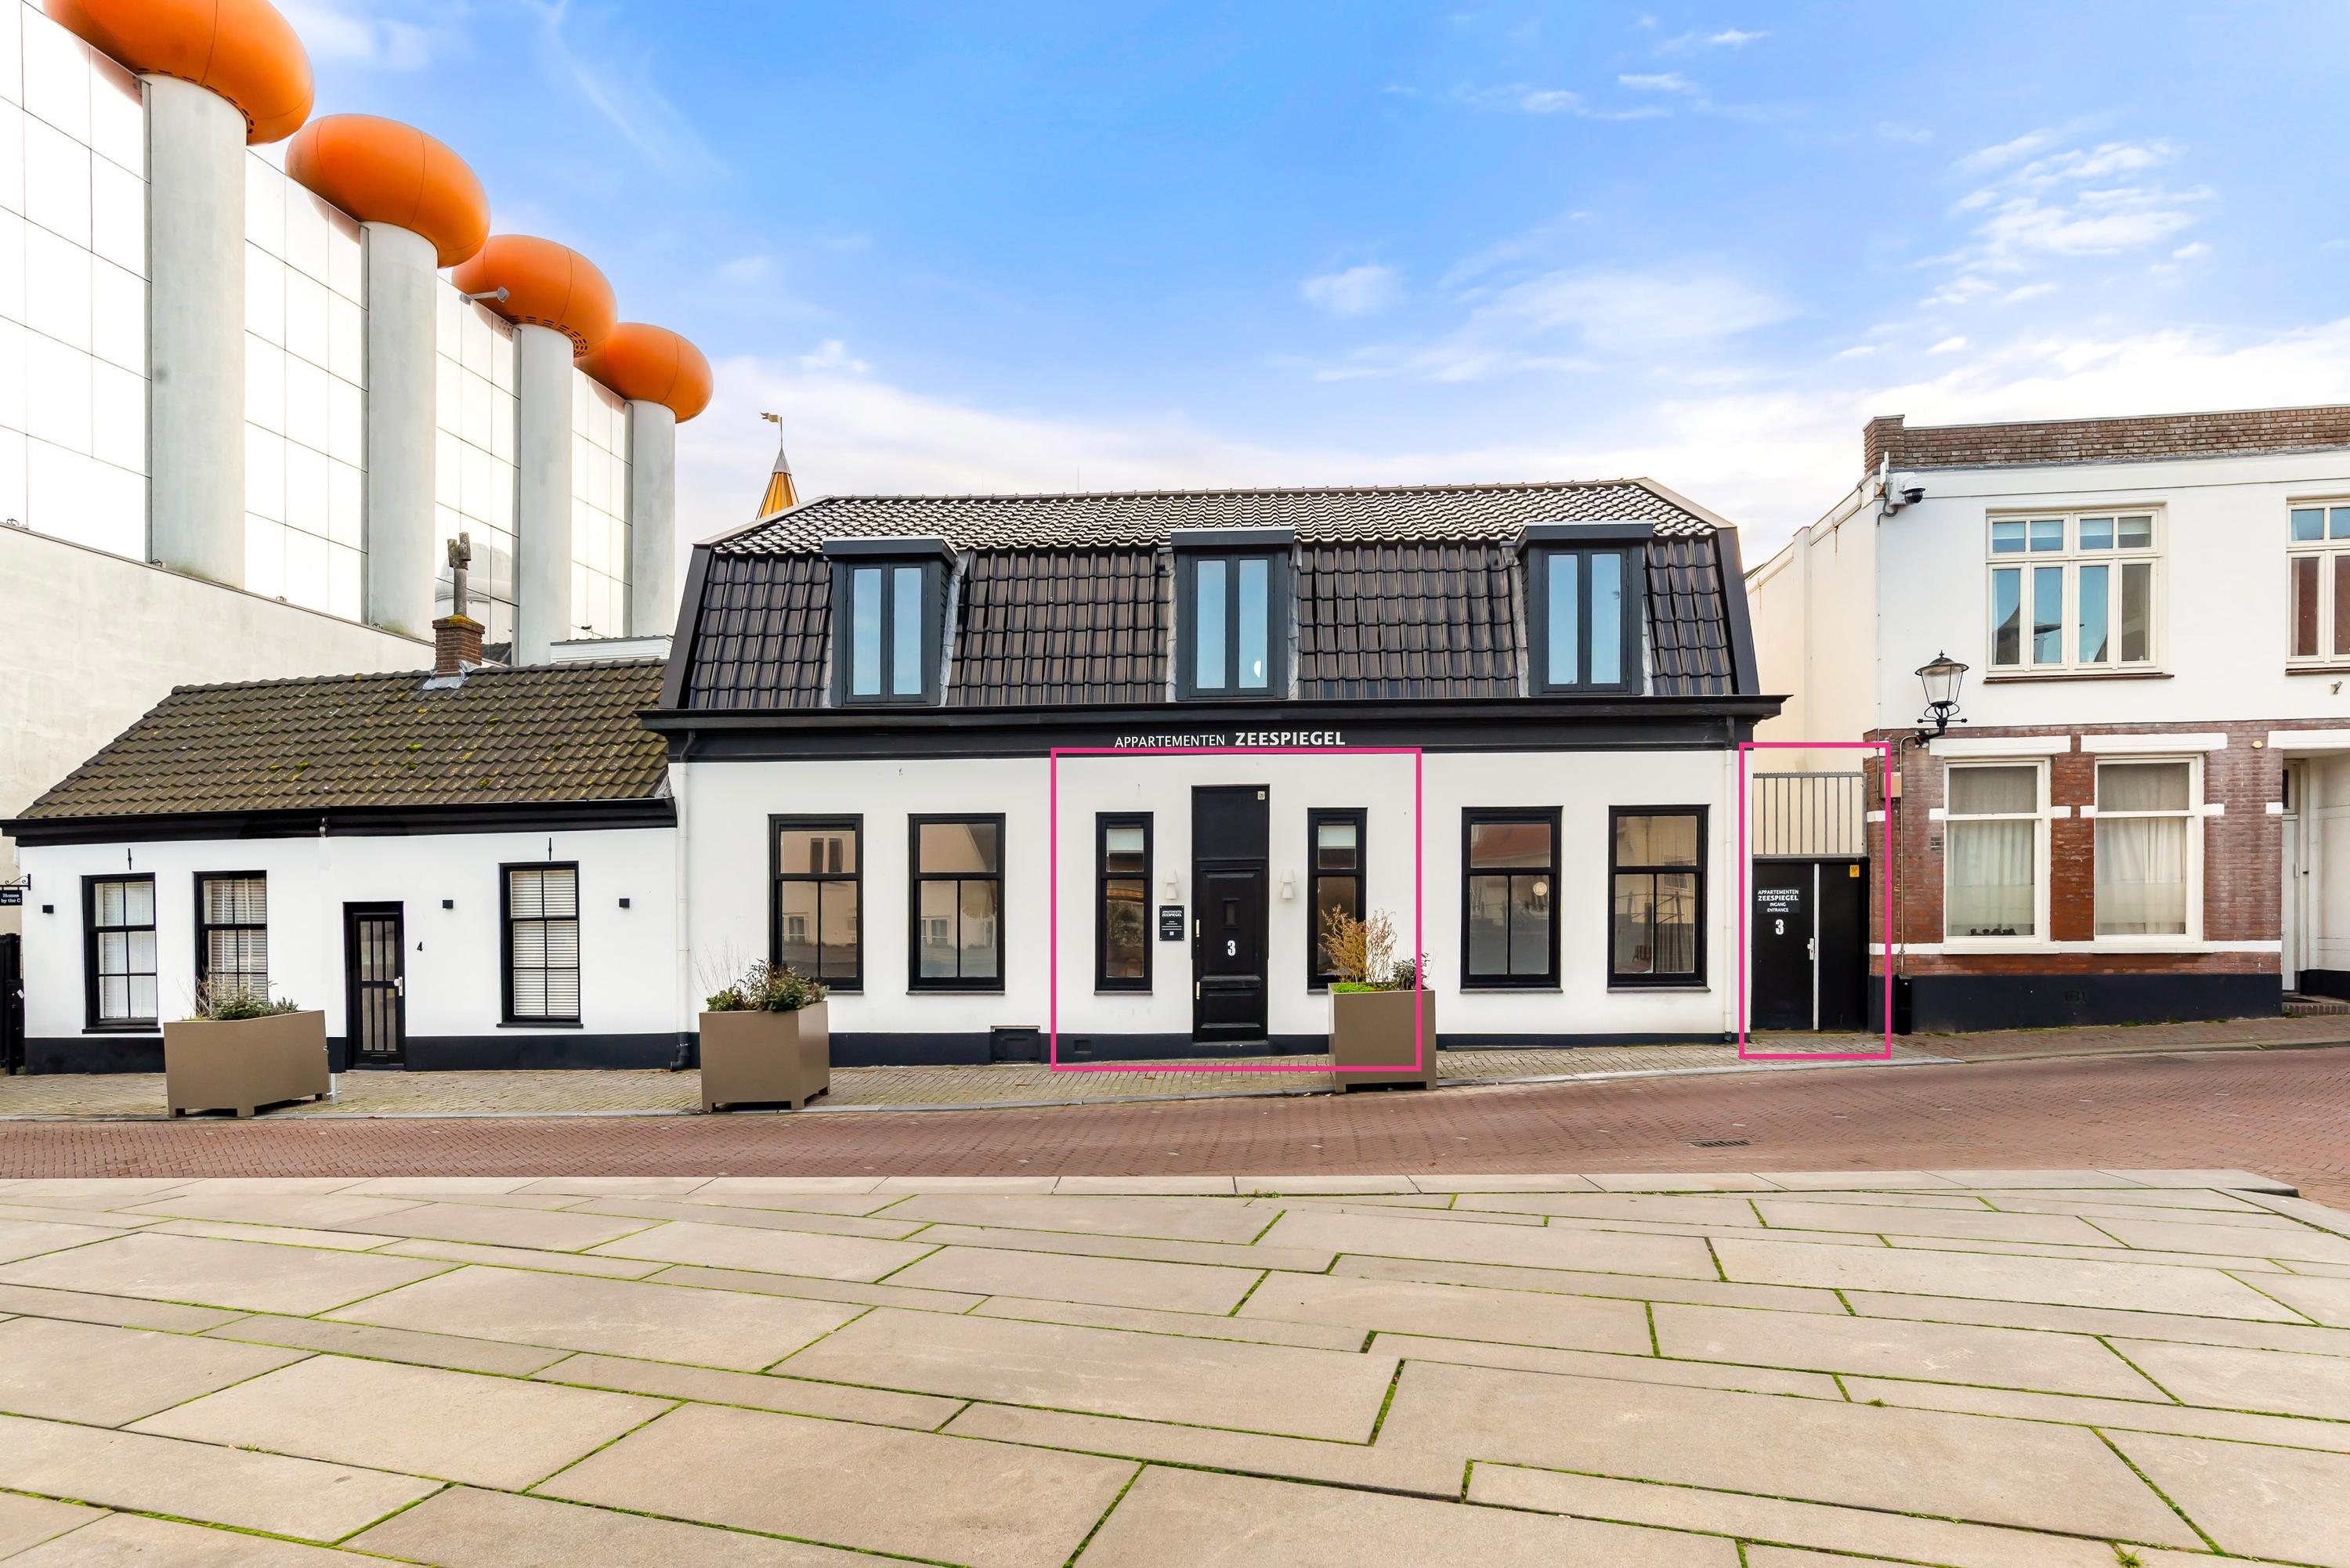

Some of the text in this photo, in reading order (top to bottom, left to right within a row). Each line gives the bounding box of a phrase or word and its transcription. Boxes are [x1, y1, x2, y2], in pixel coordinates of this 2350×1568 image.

[1114, 732, 1346, 748] APPARTEMENTEN ZEESPIEGEL
[1775, 919, 1784, 935] 3
[417, 941, 423, 952] 4
[1227, 940, 1236, 956] 3
